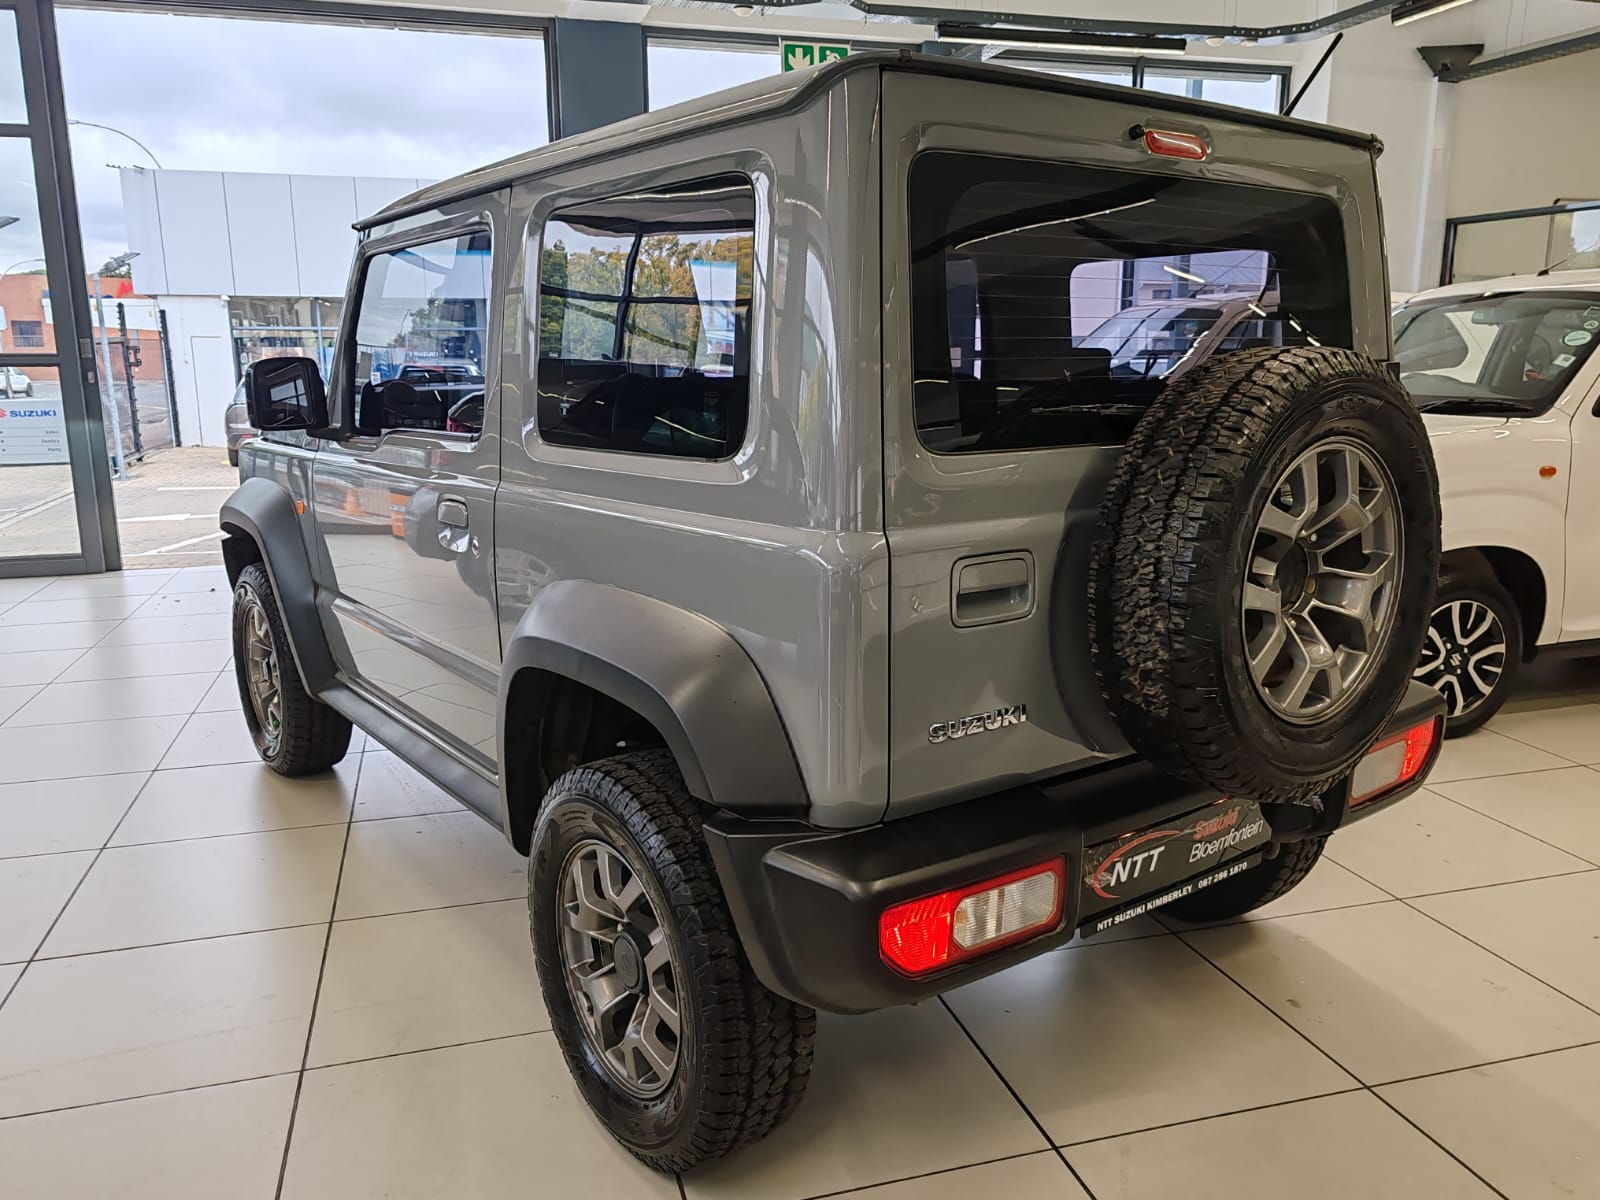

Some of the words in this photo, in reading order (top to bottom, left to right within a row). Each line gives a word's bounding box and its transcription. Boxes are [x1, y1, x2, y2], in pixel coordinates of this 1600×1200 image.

[9, 409, 57, 417] SUZUKI
[928, 703, 1027, 743] SUZUKI
[1189, 818, 1264, 863] Bloemfontein
[1110, 846, 1165, 887] NTT
[1097, 918, 1113, 932] NTT
[1114, 904, 1146, 924] SUZUKI
[1147, 884, 1193, 911] KIMBERLEY
